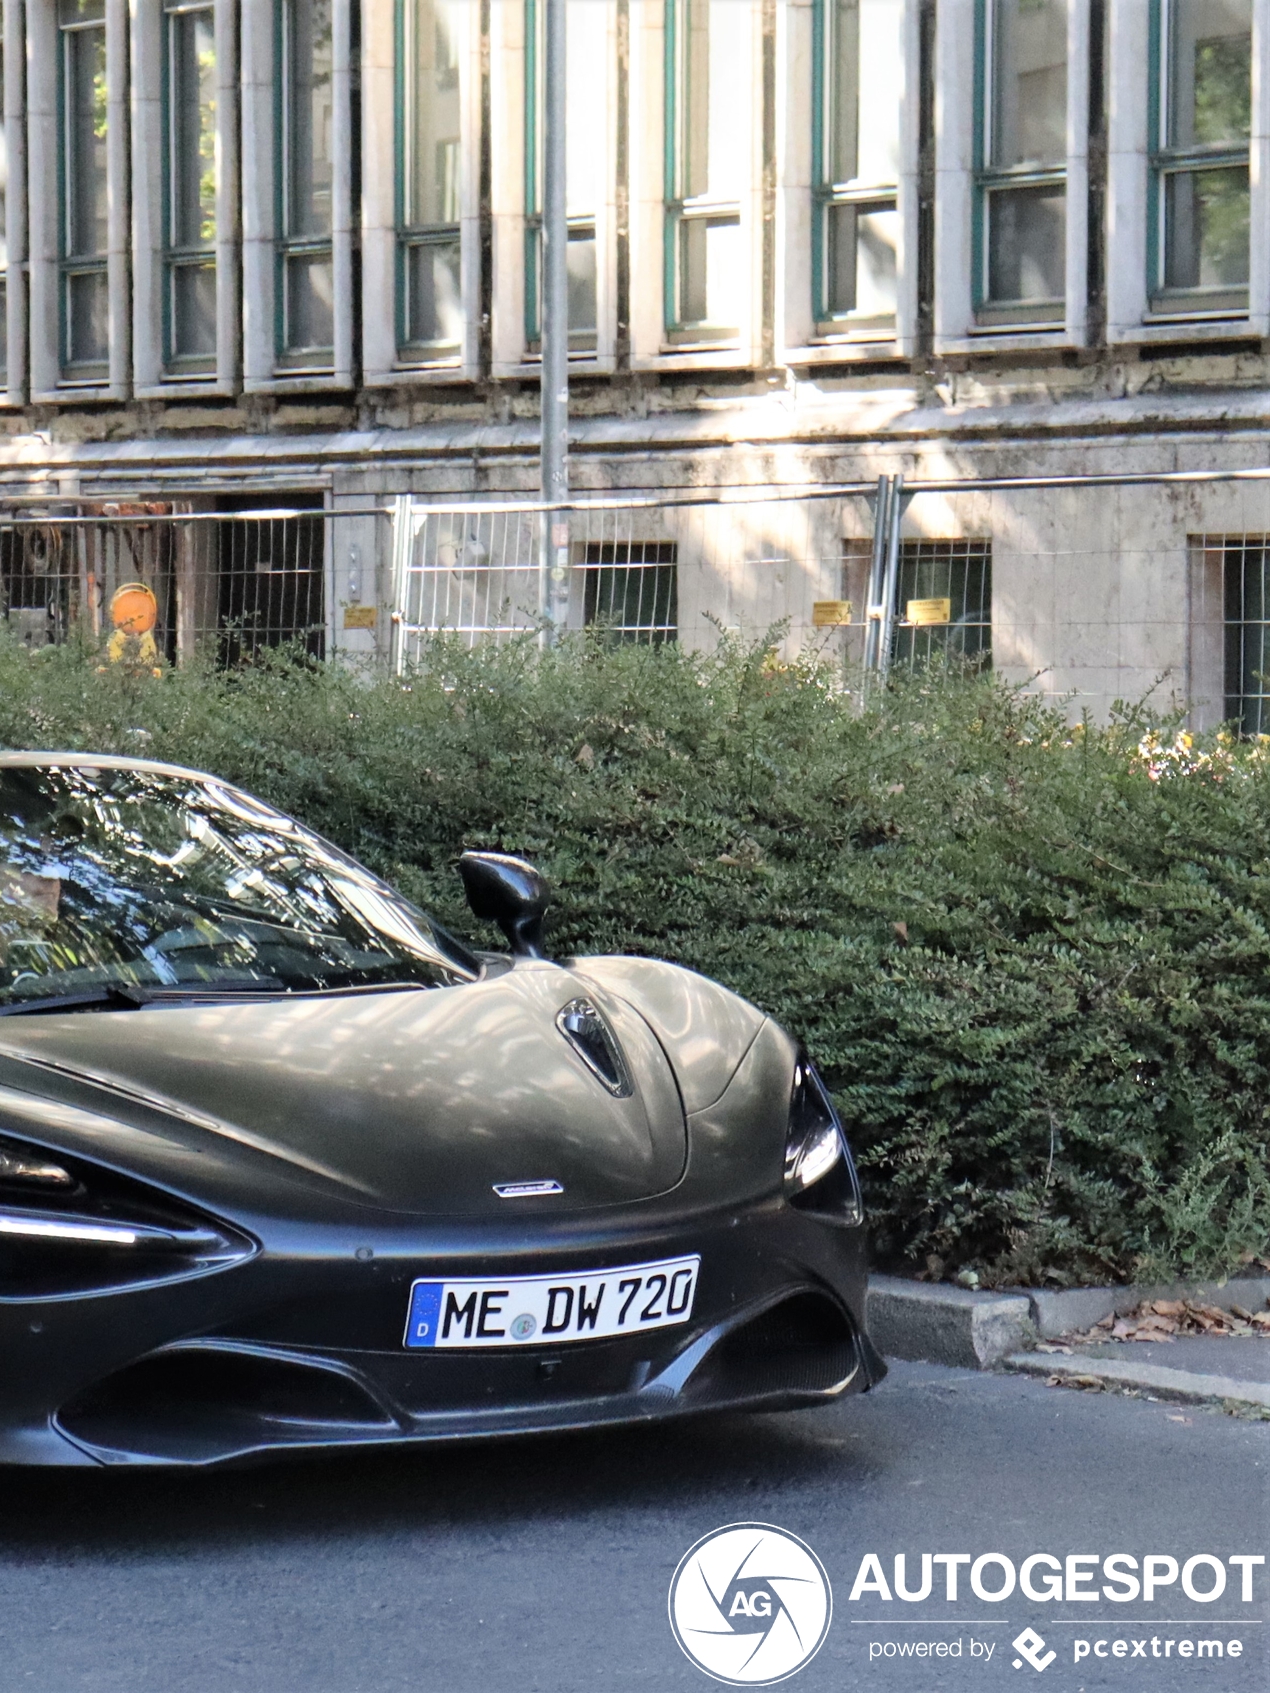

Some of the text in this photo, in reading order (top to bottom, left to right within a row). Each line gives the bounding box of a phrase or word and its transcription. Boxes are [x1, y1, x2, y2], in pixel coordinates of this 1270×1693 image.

[441, 1268, 693, 1339] ME DW 720
[417, 1322, 429, 1337] D
